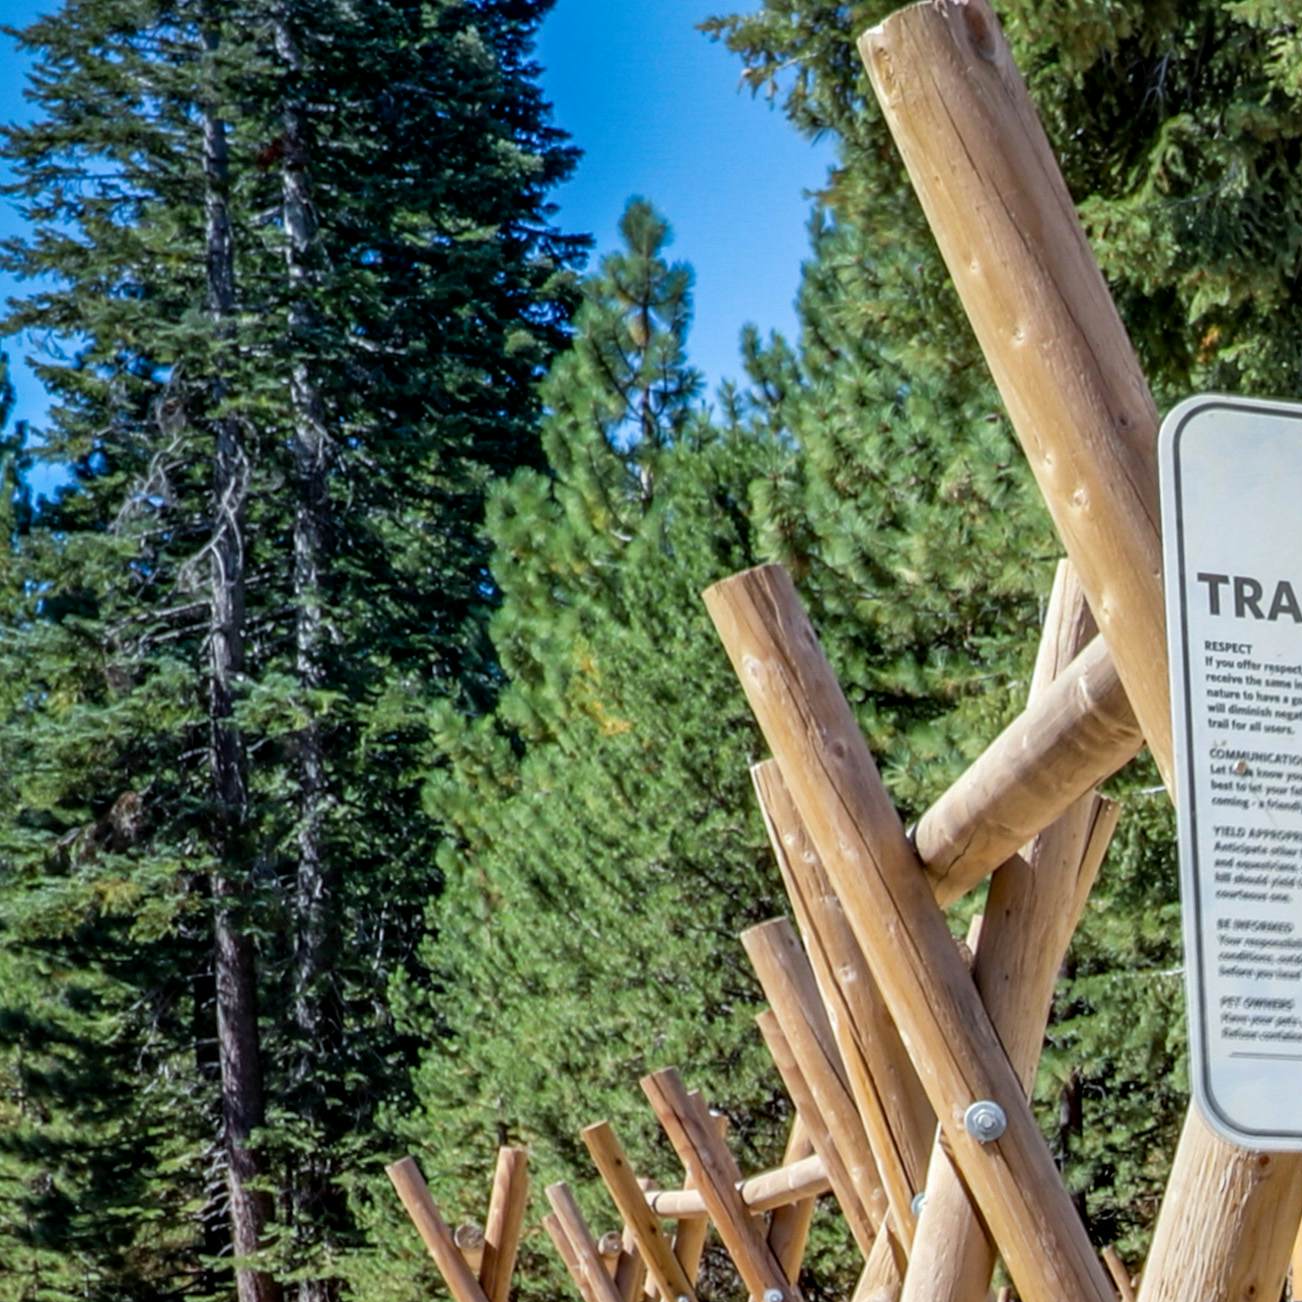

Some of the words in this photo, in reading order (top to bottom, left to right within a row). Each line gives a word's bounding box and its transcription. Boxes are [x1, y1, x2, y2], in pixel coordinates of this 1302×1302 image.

[1205, 642, 1252, 654] RESPECT
[1206, 674, 1242, 685] receive
[1207, 689, 1240, 699] nature
[1228, 705, 1272, 717] diminish
